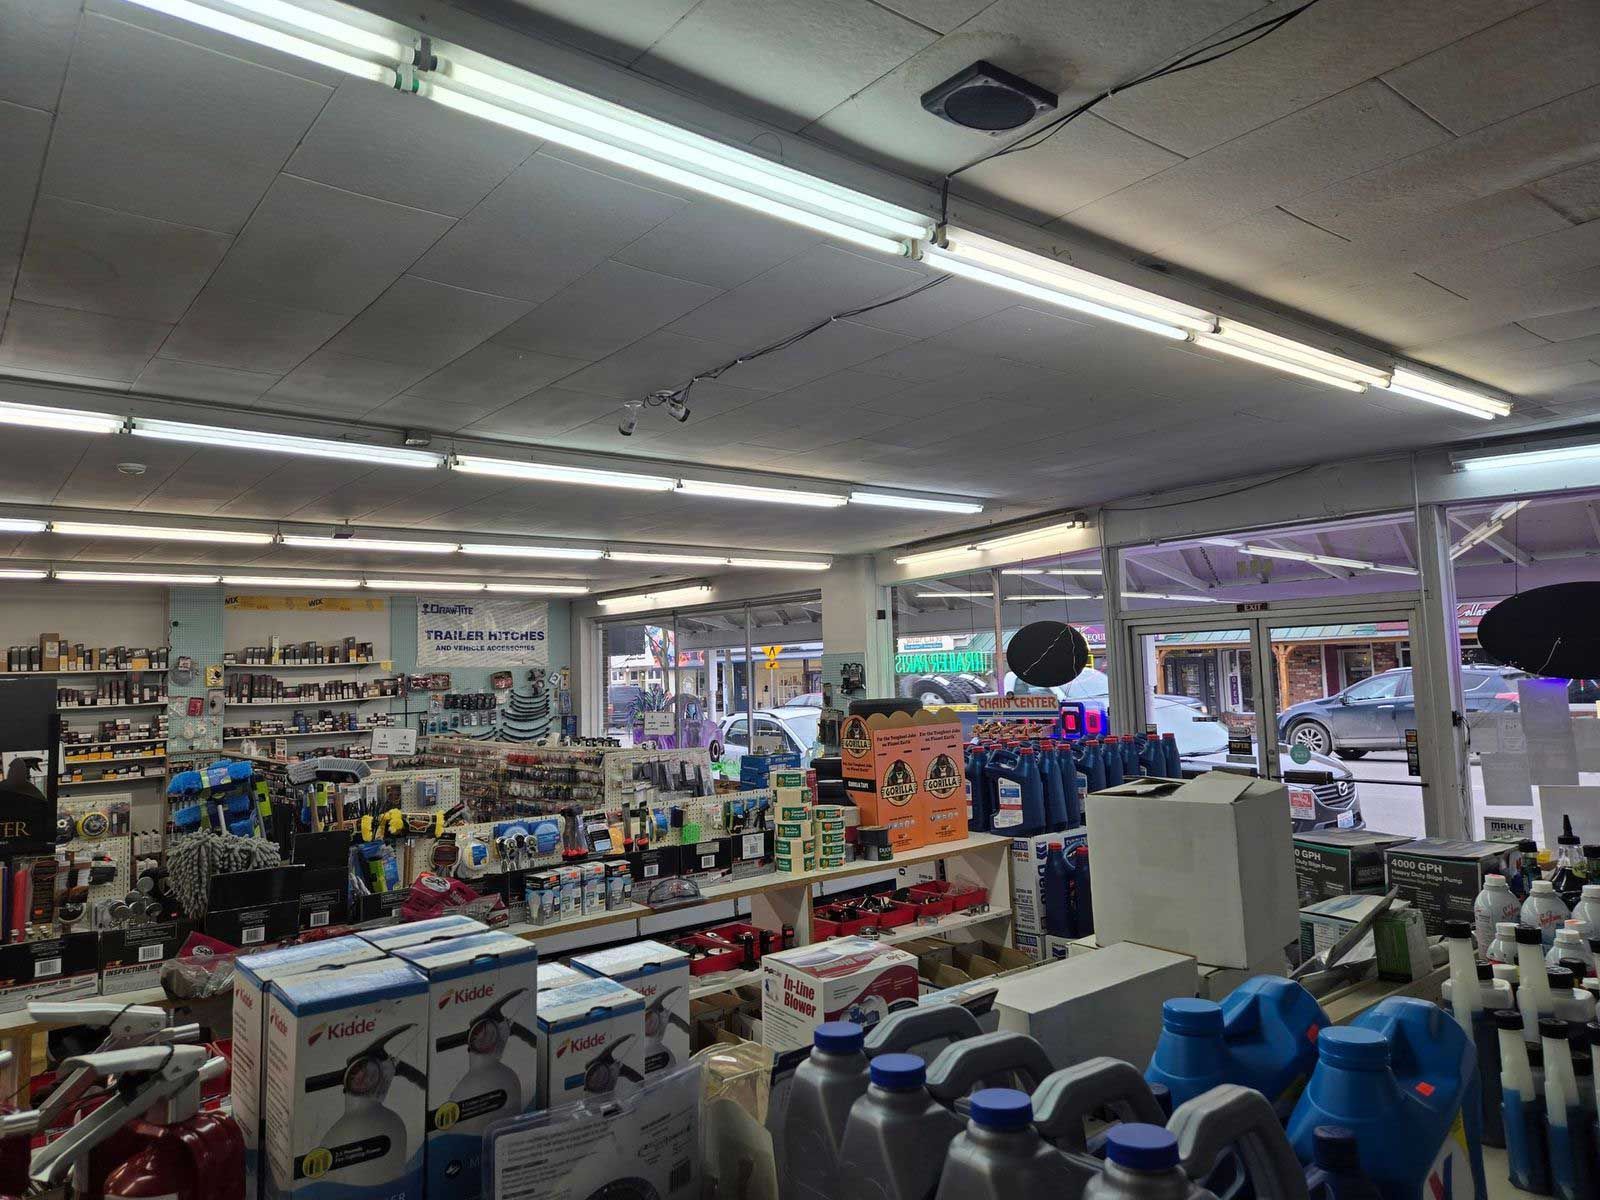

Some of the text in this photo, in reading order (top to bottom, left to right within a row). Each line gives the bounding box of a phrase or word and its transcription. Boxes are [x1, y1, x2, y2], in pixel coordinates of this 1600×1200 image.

[1244, 603, 1261, 611] EXIT
[425, 629, 545, 641] TRAILER HITCHES
[978, 695, 1057, 709] CHAIN CENTER
[845, 740, 868, 749] GORILLA
[885, 784, 913, 796] GORILLA
[928, 779, 957, 789] GORILLA
[1491, 822, 1524, 831] MAHLE
[1301, 849, 1321, 861] GPH
[1391, 858, 1443, 874] 4000 GPH
[1411, 871, 1425, 879] Duty
[1444, 875, 1463, 885] Pump
[105, 965, 148, 977] INSPECTION
[783, 973, 815, 1000] In-Line
[240, 986, 253, 1009] Kidde
[454, 984, 494, 1004] Kidde
[783, 991, 816, 1018] Blower
[274, 1008, 289, 1037] Kidde
[327, 1019, 376, 1040] Kidde
[570, 1033, 606, 1053] Kidde
